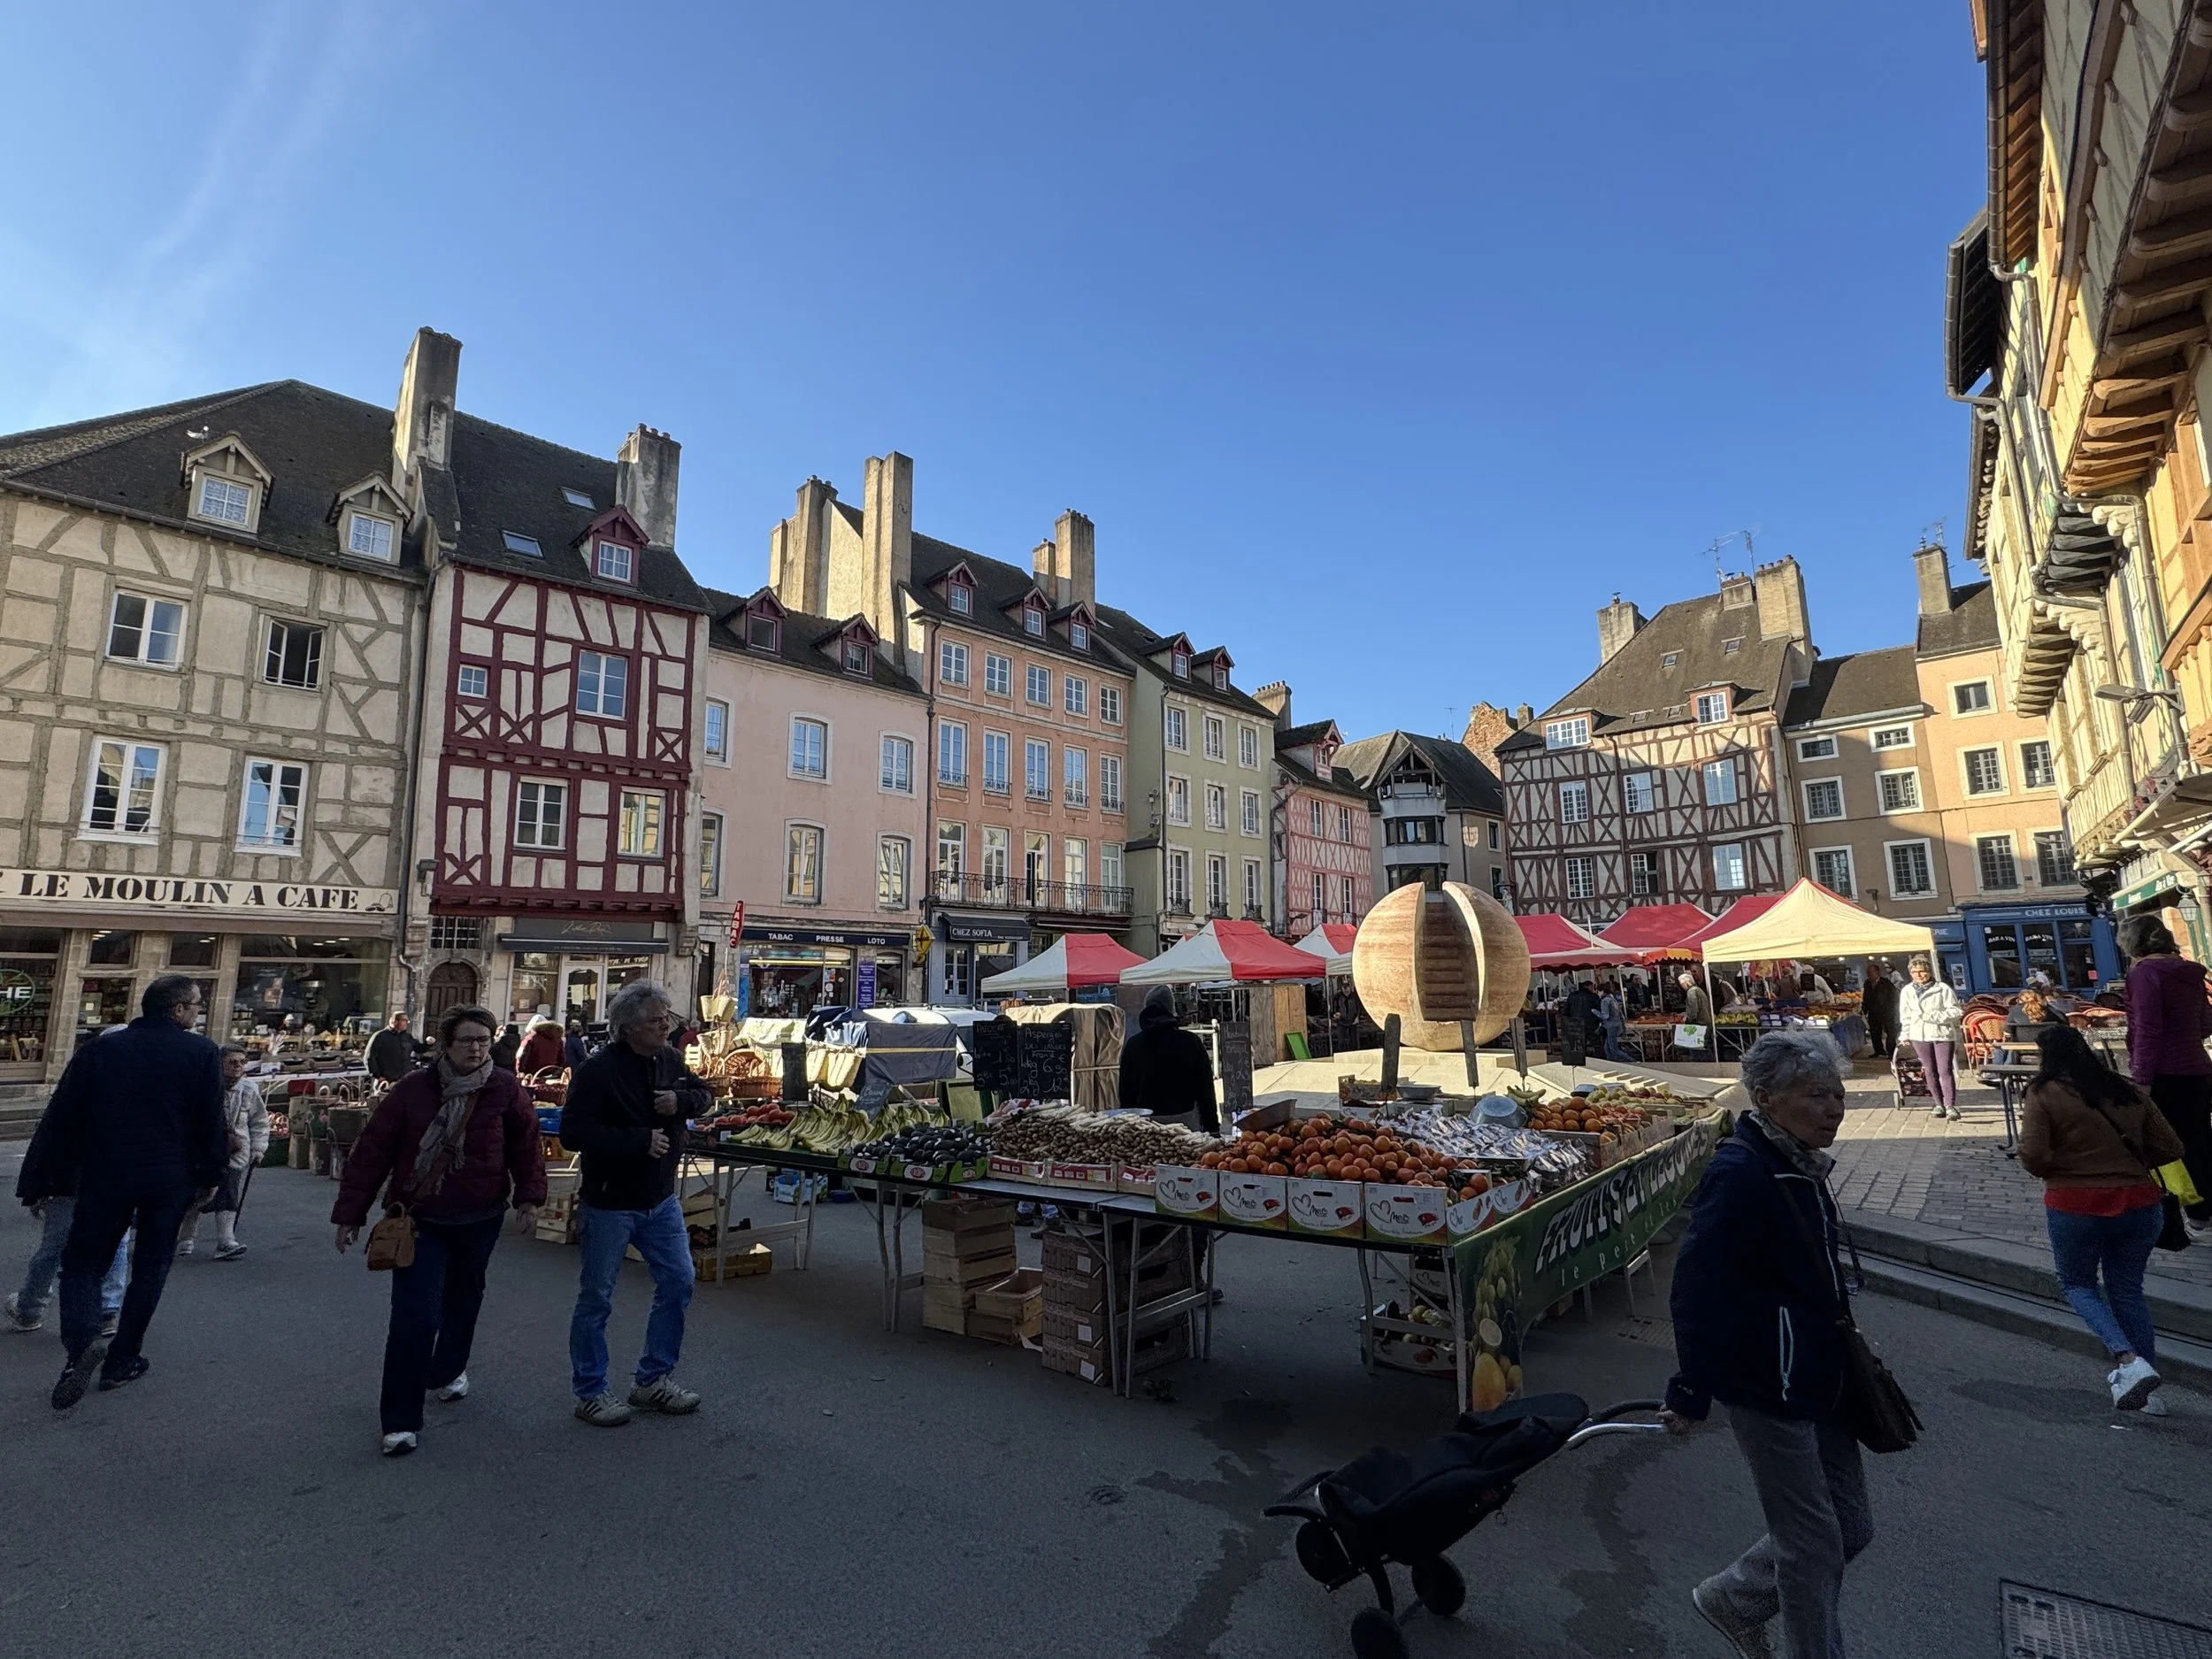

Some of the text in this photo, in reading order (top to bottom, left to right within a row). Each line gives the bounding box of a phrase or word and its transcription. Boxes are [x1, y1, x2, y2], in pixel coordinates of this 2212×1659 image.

[18, 873, 358, 910] LE MOULIN A CAFE
[2055, 907, 2085, 916] LOUIS
[730, 902, 741, 946] TABAC
[1535, 1167, 1630, 1274] FRUITS
